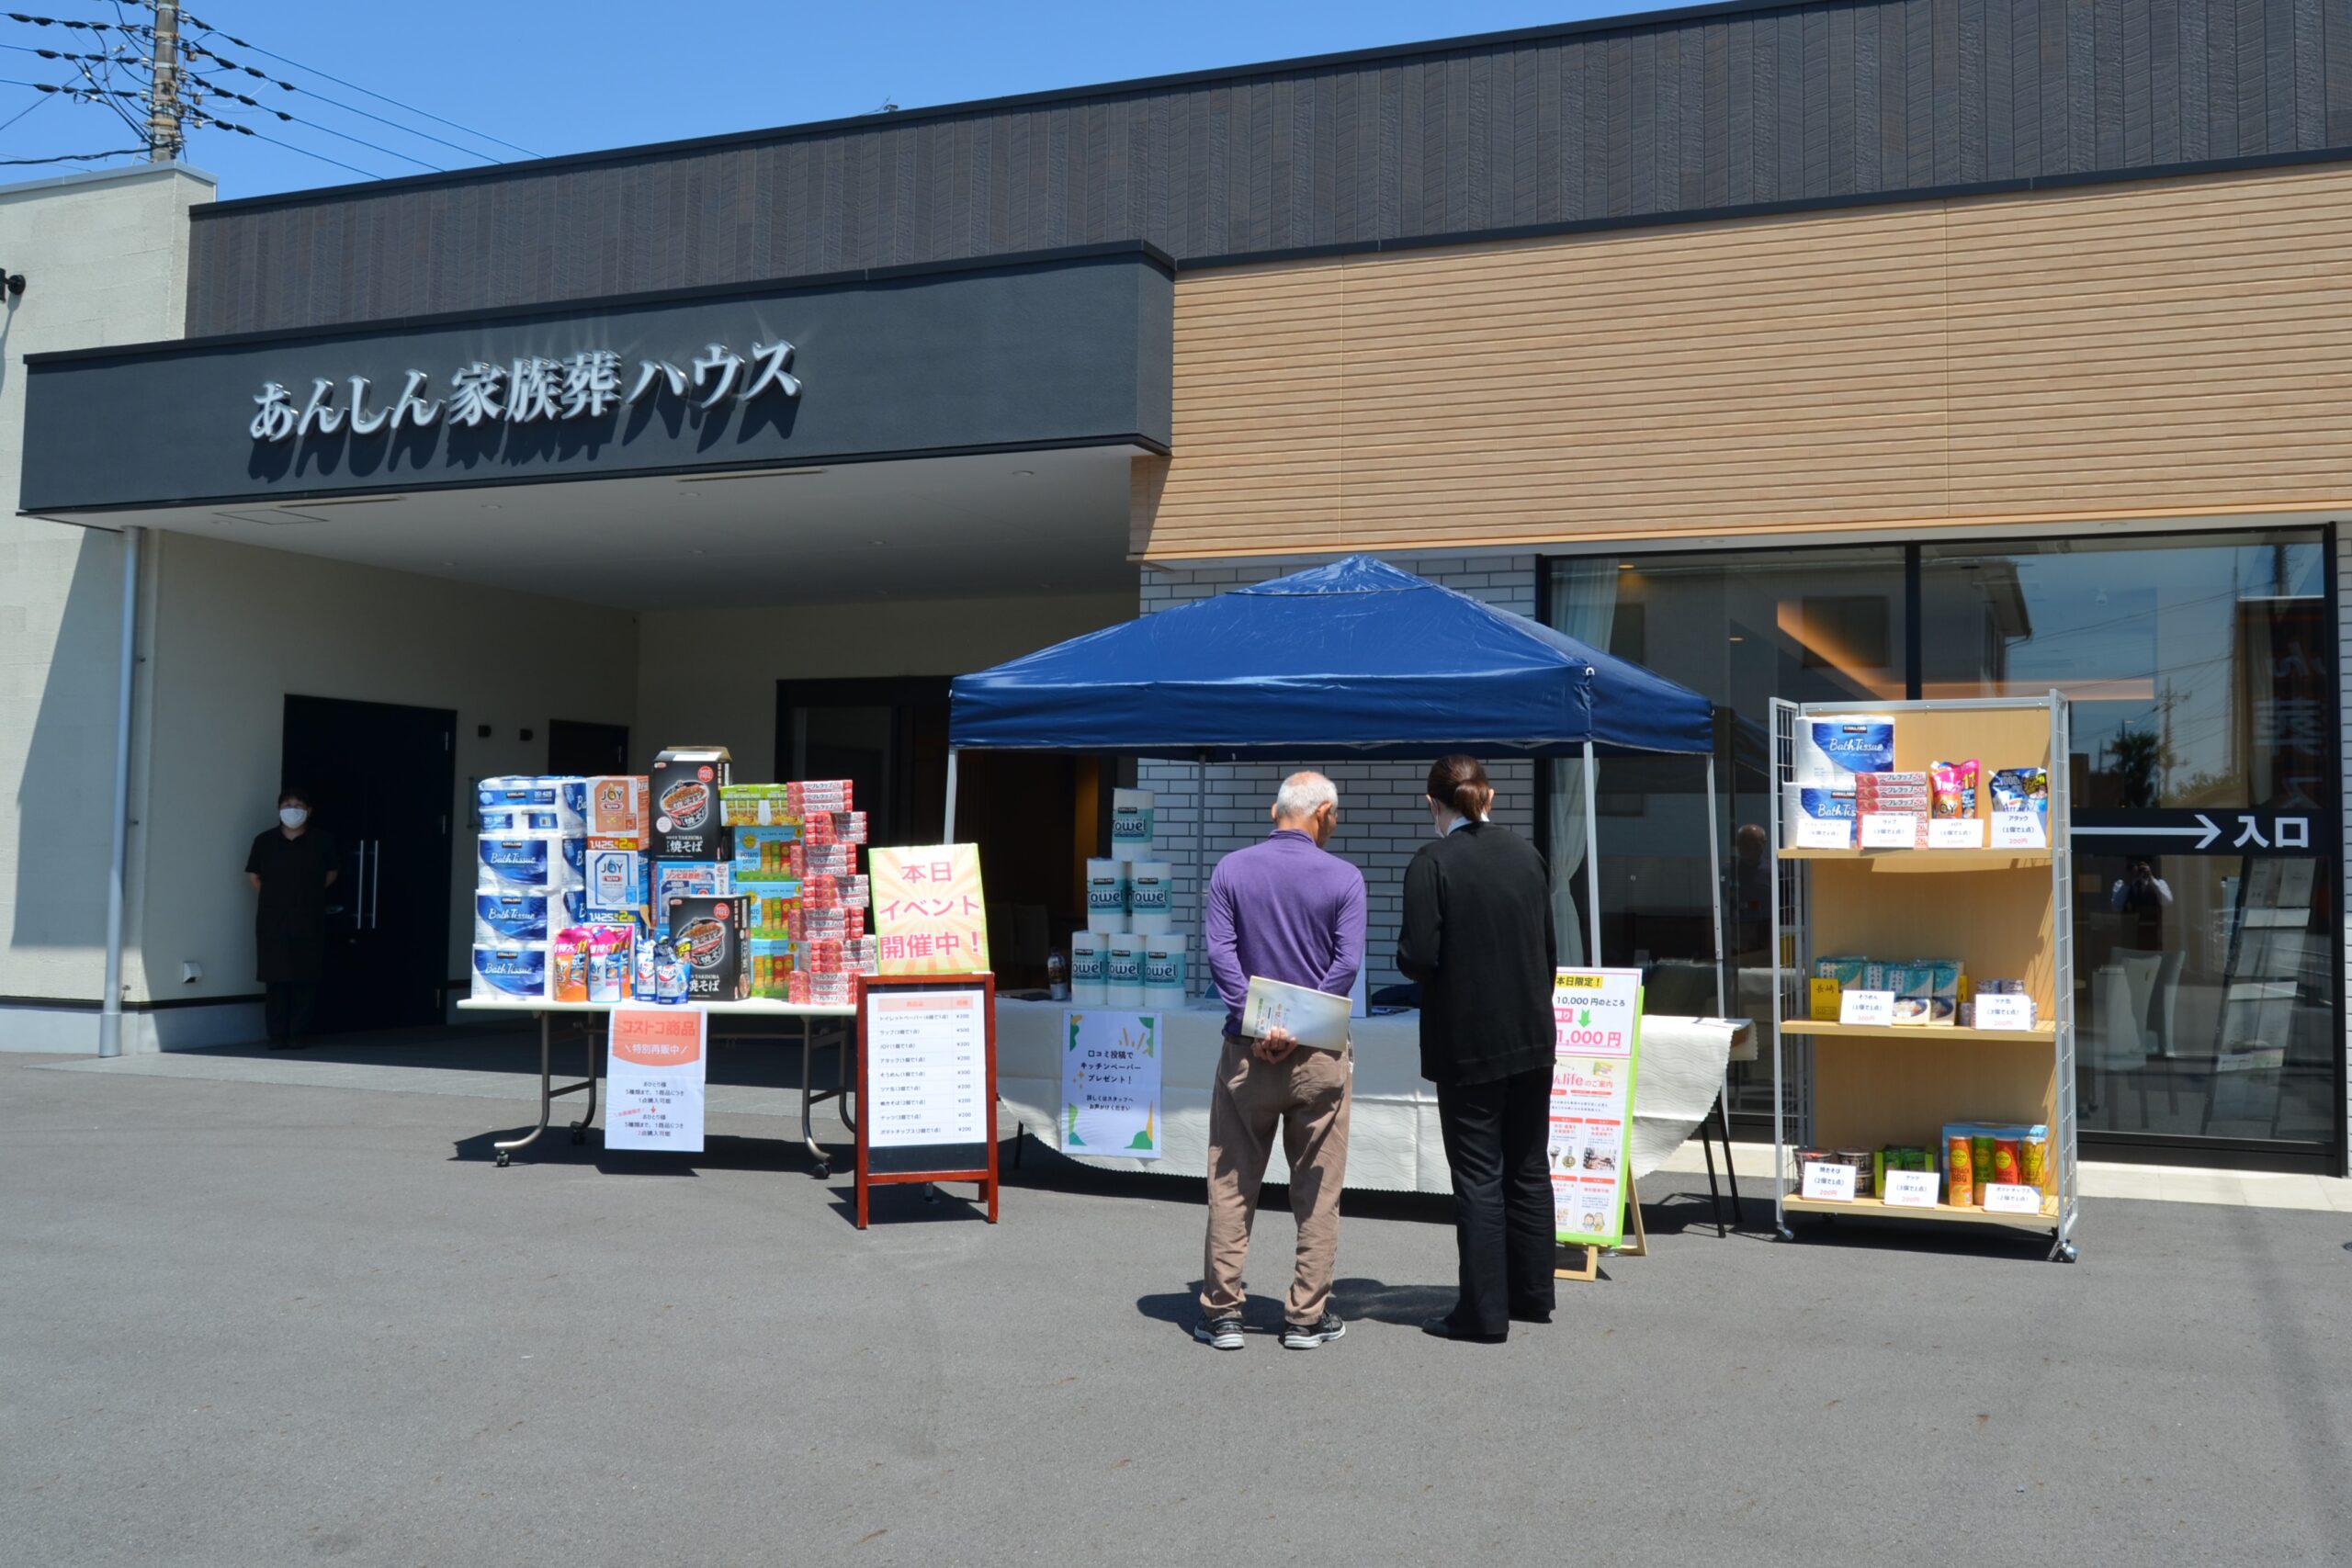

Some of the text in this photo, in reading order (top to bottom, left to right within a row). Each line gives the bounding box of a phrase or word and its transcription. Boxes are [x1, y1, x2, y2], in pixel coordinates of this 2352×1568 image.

[1829, 738, 1883, 751] Bath Tissue
[601, 787, 623, 801] JOY
[1817, 803, 1856, 817] Bath Tis
[2233, 815, 2309, 849] 入口
[601, 863, 623, 874] JOY
[901, 862, 952, 884] 本日
[879, 895, 979, 921] イベント
[1072, 961, 1102, 974] owel
[1108, 962, 1140, 975] owel
[1146, 964, 1177, 976] owel
[623, 1020, 695, 1037] コストコ商品
[1088, 1050, 1134, 1060] 口コミ投稿で
[1080, 1062, 1141, 1070] キッチンペーパー
